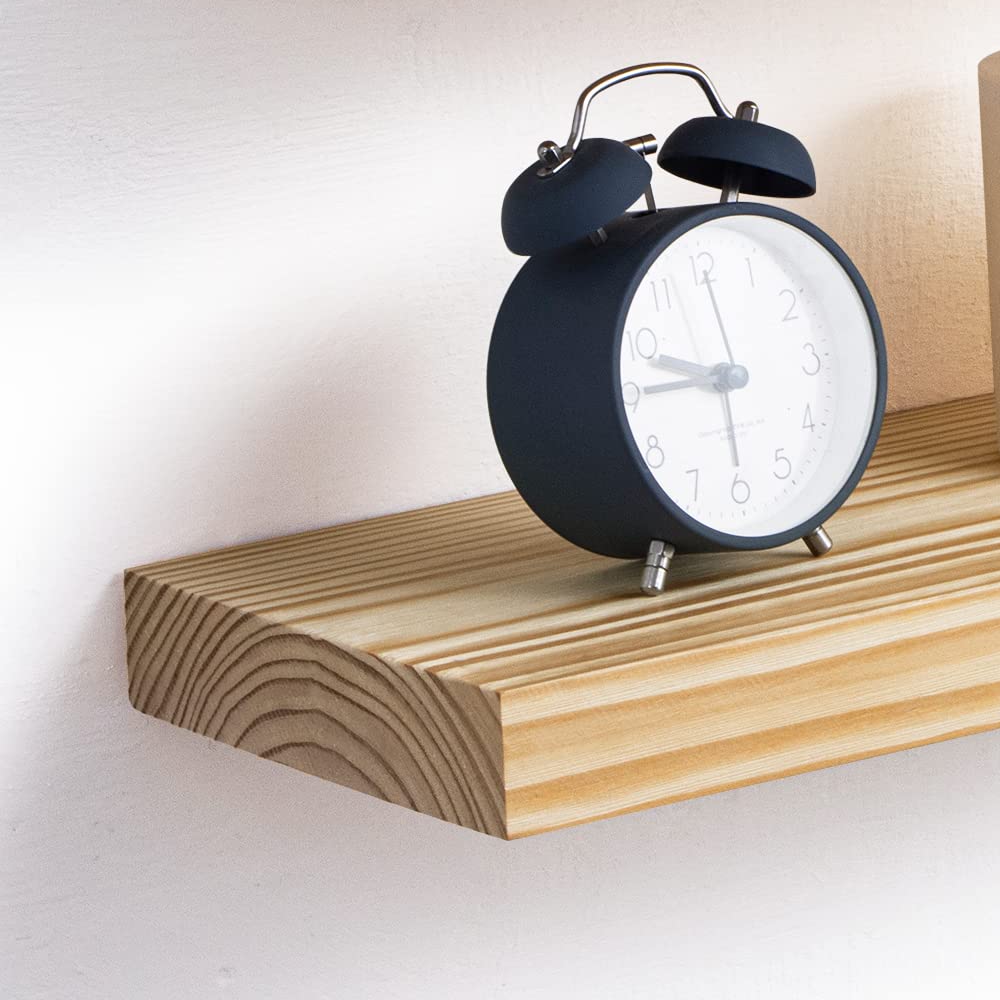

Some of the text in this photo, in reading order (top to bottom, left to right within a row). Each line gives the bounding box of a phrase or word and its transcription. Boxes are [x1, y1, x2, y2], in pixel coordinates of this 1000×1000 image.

[689, 252, 717, 287] 12
[745, 257, 754, 288] 1
[651, 278, 671, 312] 11
[779, 289, 799, 322] 2
[627, 328, 657, 361] 10
[802, 343, 820, 376] 3
[622, 381, 640, 413] 9
[802, 403, 815, 433] 4
[646, 435, 665, 468] 8
[773, 448, 791, 479] 5
[686, 468, 699, 502] 7
[731, 473, 750, 504] 6
